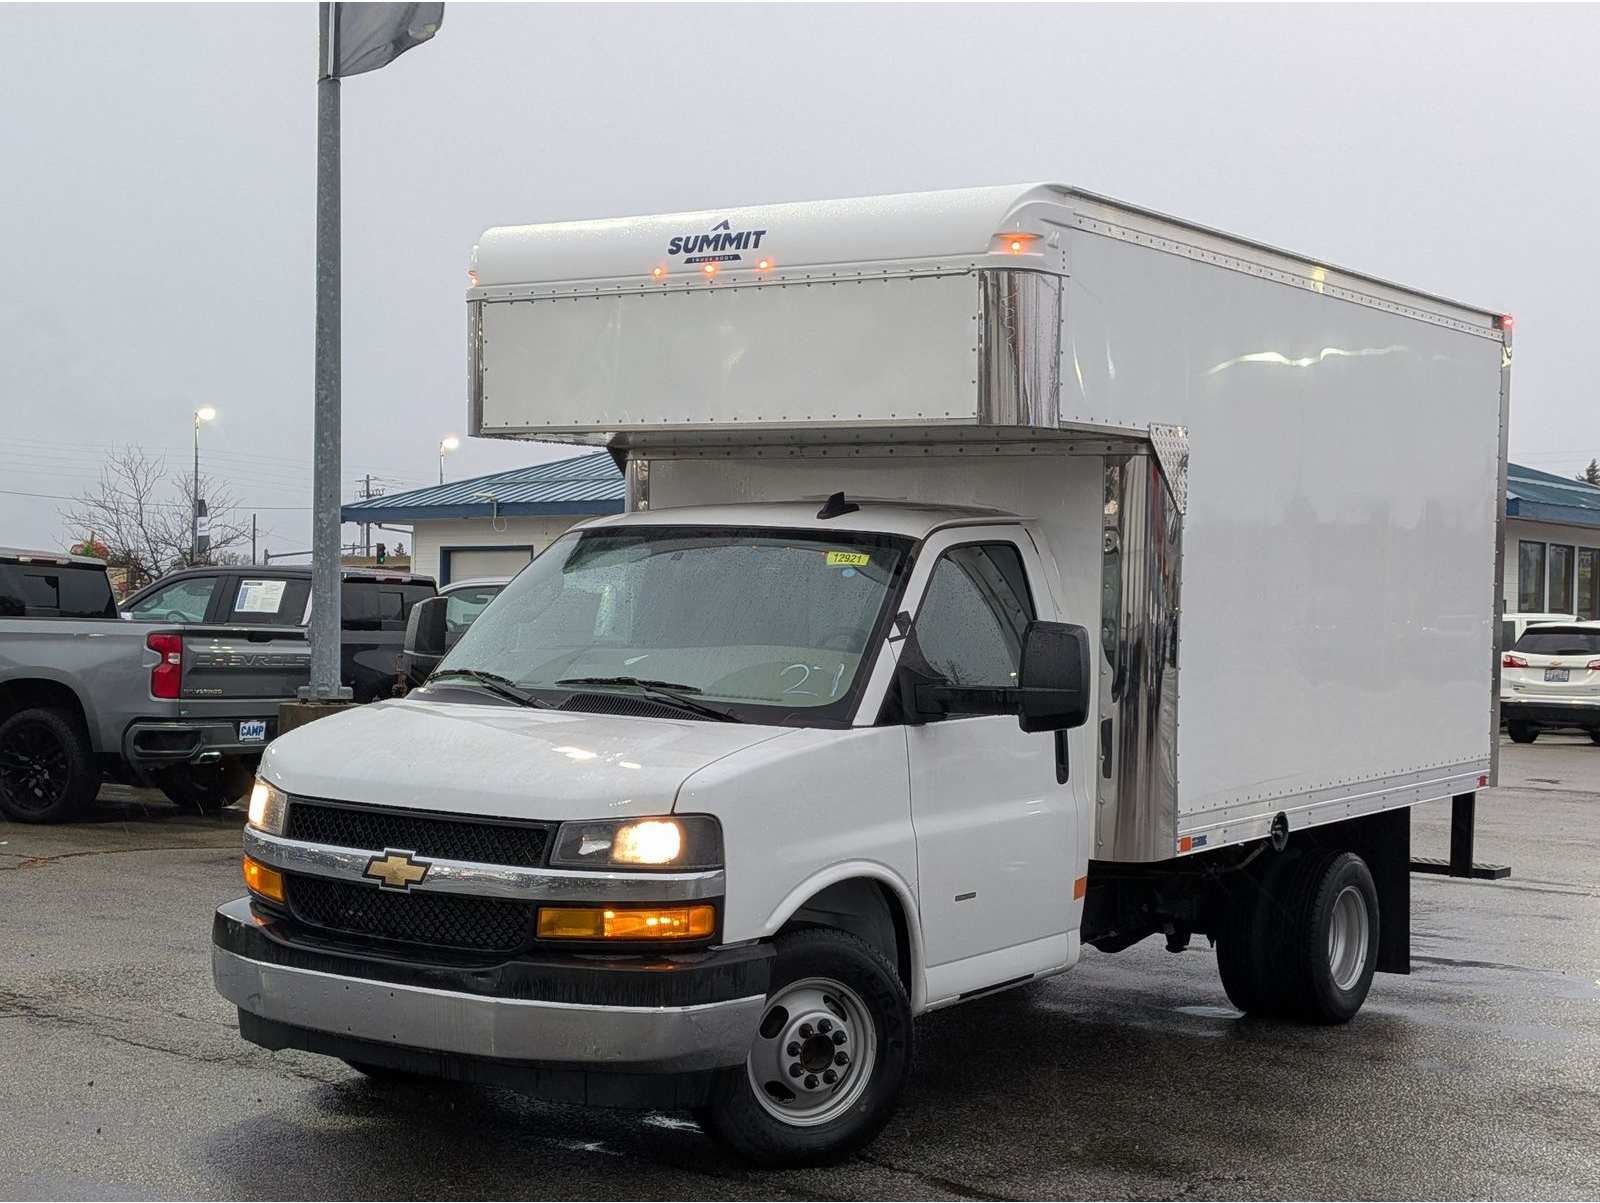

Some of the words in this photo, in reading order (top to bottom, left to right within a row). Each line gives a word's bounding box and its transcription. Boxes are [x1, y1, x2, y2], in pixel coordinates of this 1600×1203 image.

[667, 230, 766, 255] SUMMIT
[833, 553, 863, 563] 12921
[241, 725, 264, 737] CAMP
